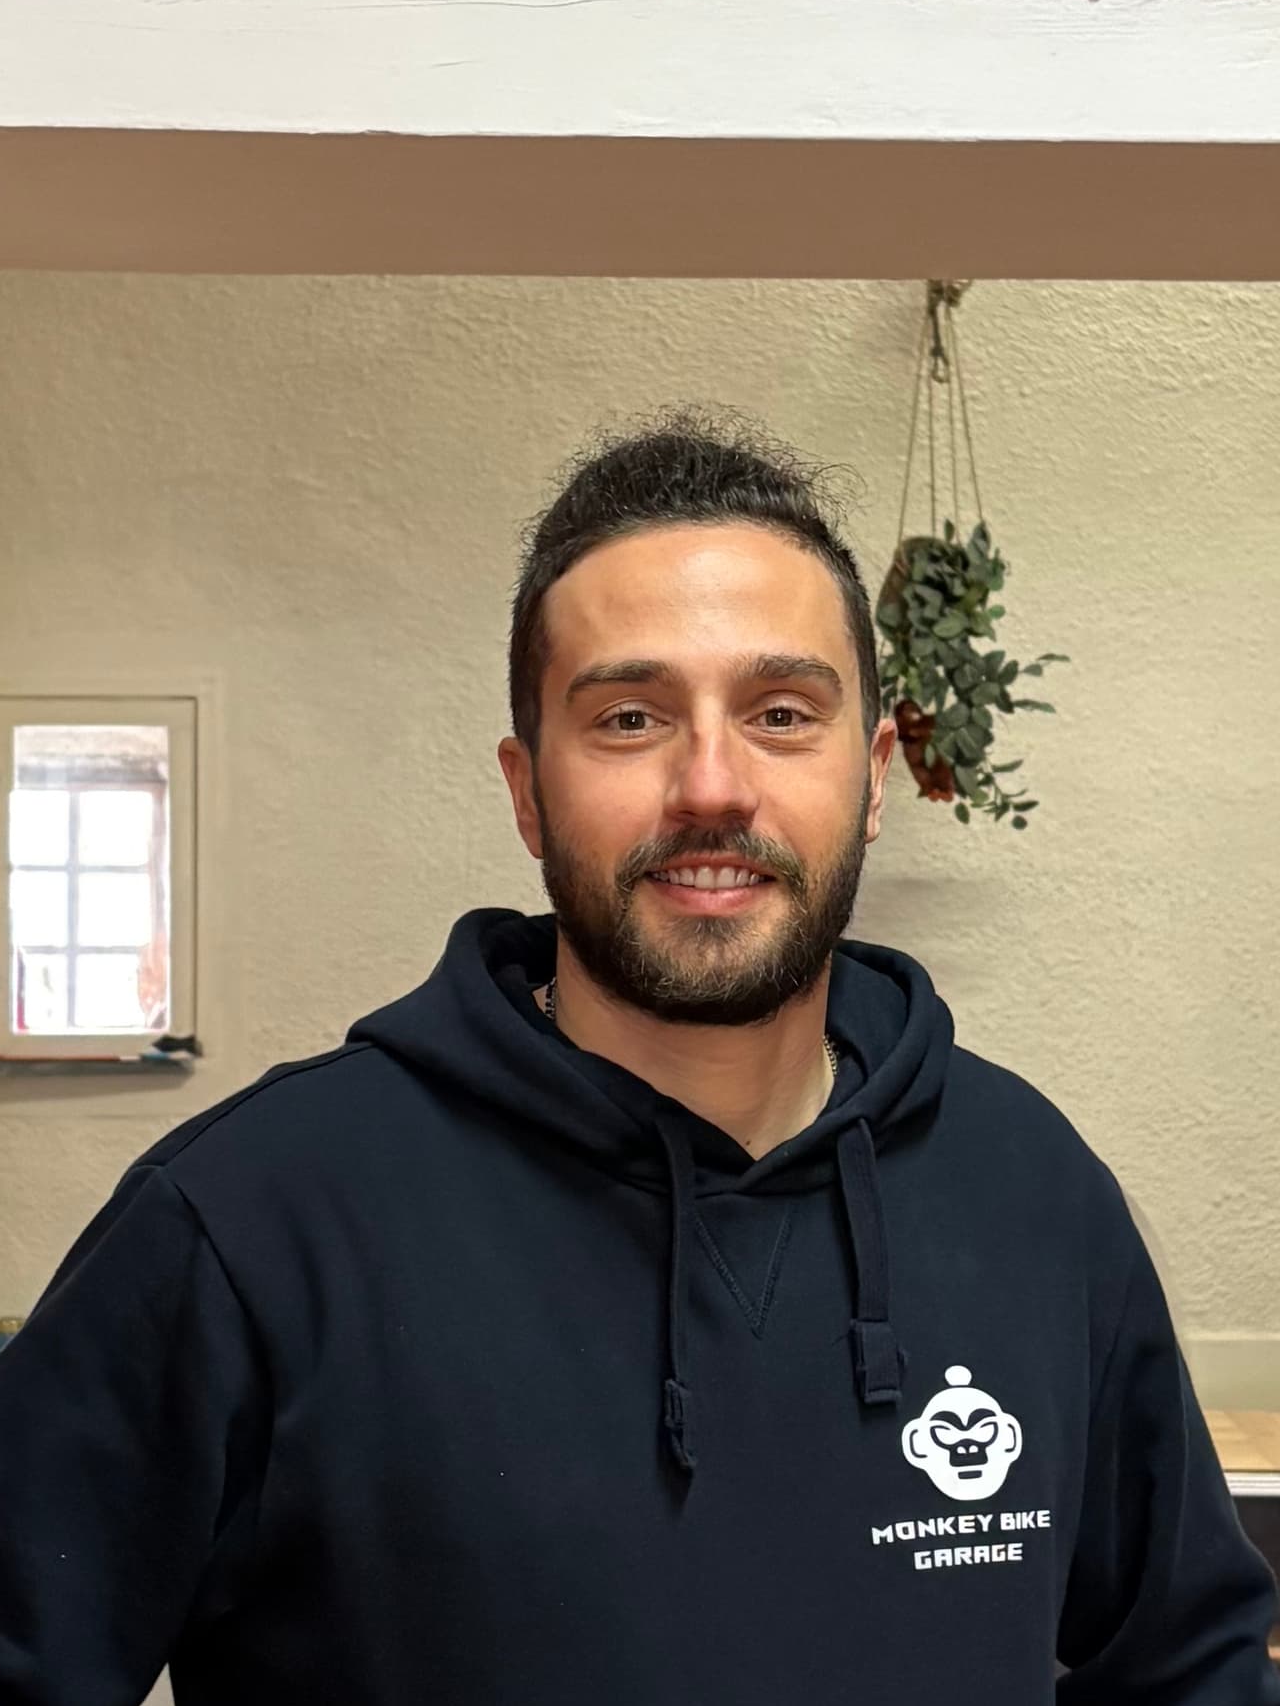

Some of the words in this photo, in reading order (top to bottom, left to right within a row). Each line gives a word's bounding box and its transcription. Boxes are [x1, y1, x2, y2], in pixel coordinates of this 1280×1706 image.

[871, 1513, 993, 1545] MONKEY
[1000, 1509, 1051, 1531] BIKE
[913, 1542, 1024, 1570] GARAGE
